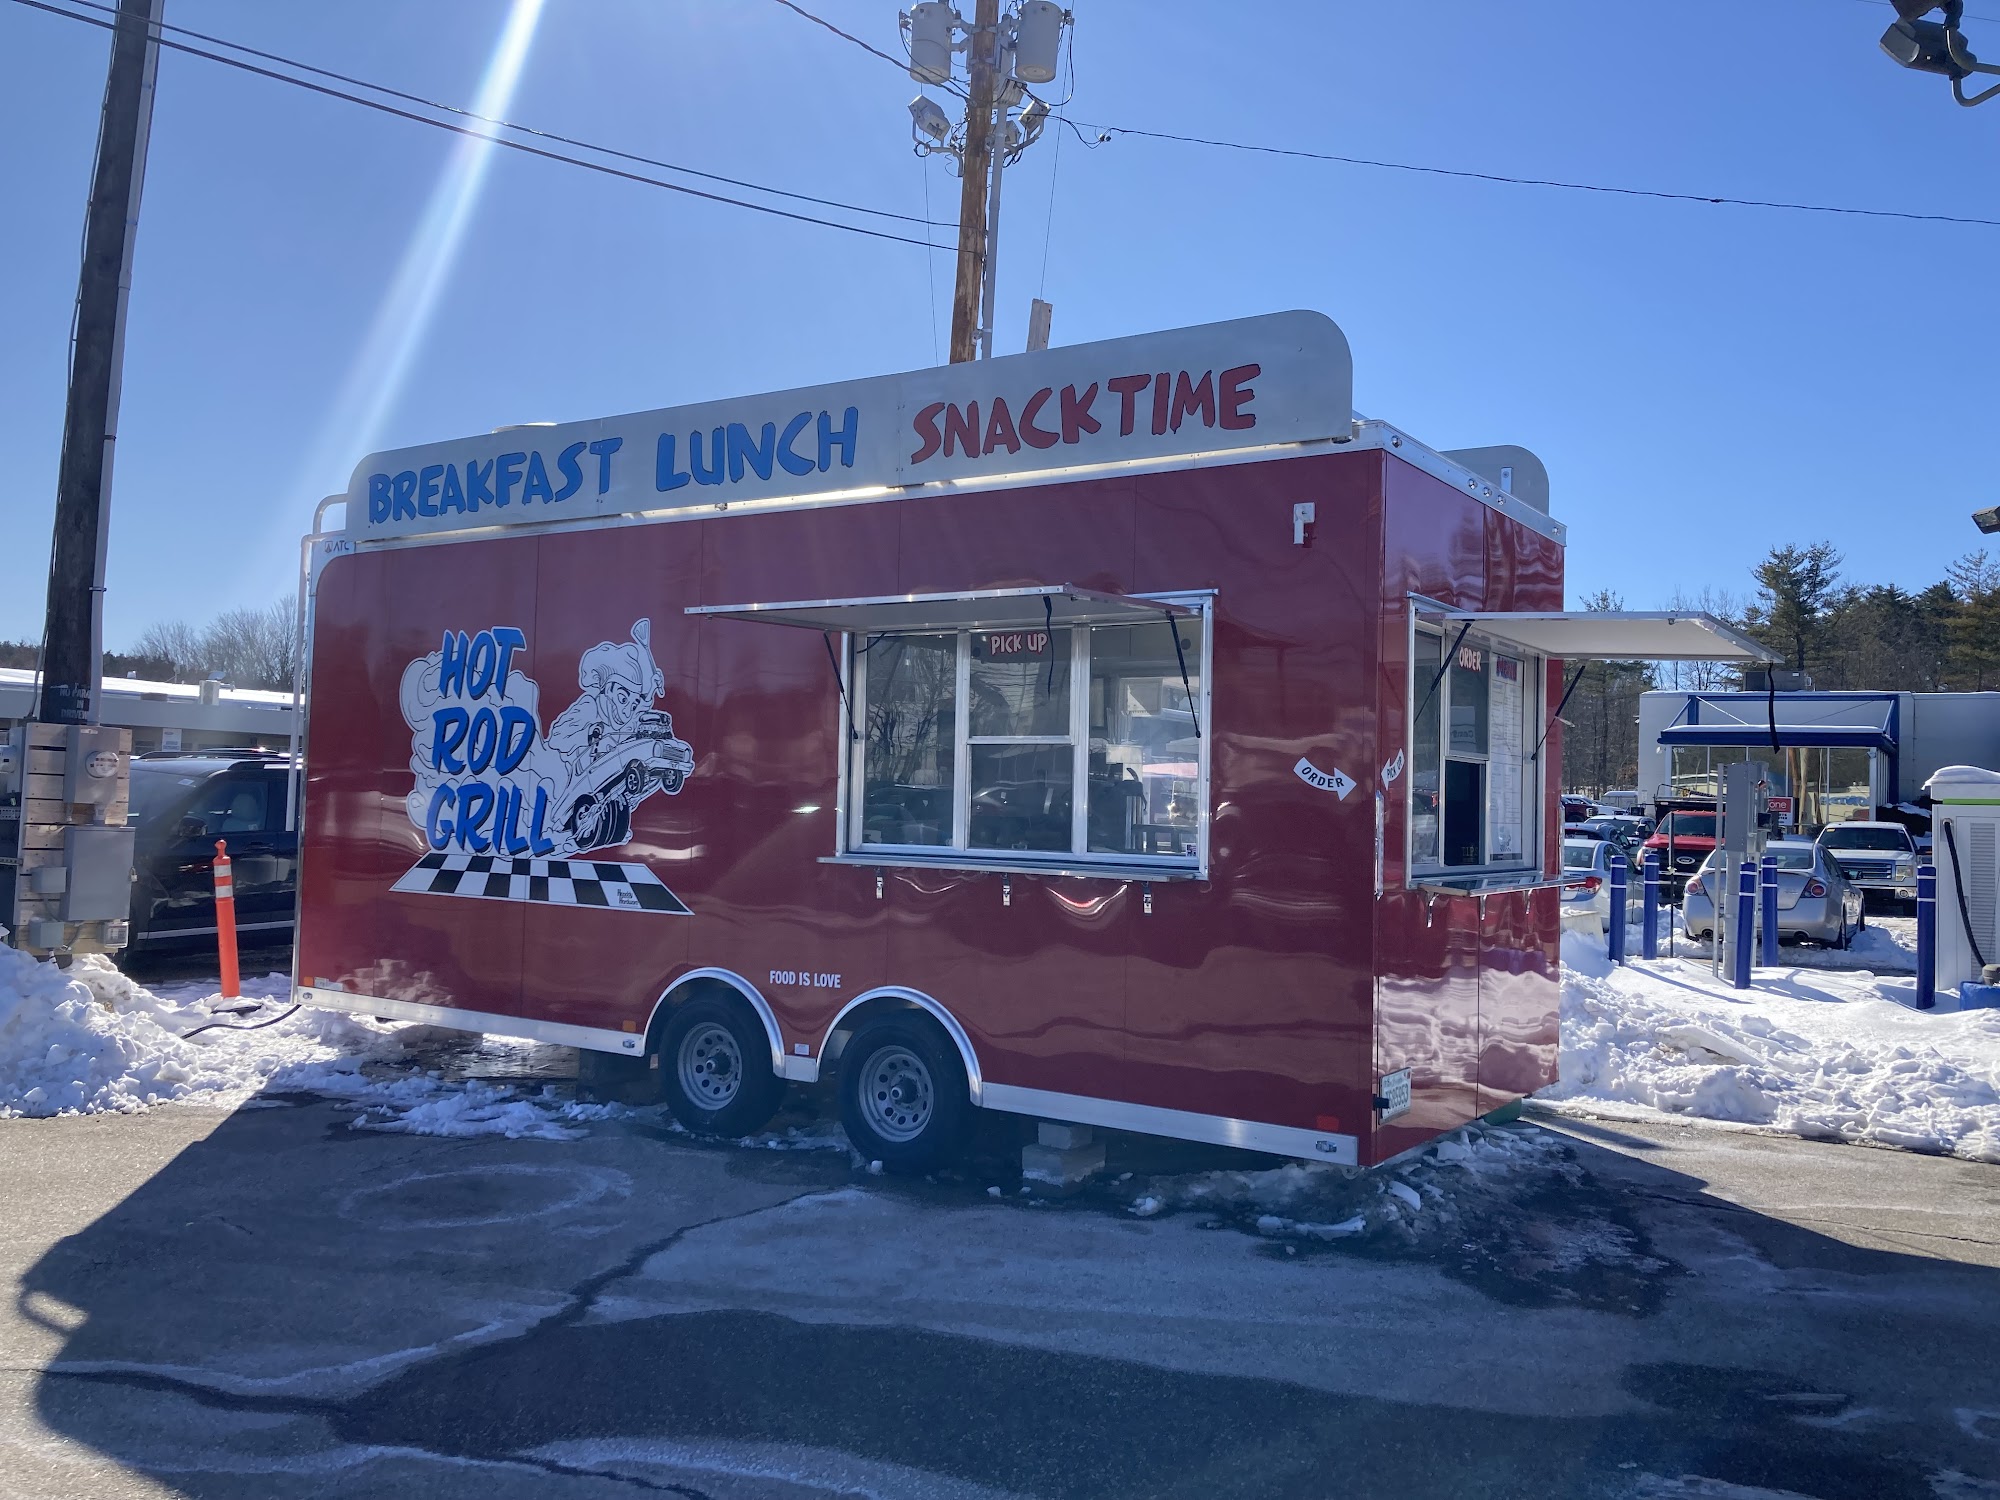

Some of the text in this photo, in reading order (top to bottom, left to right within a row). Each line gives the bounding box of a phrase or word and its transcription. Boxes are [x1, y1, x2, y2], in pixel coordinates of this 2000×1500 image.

[368, 437, 623, 524] BREAKFAST
[656, 407, 858, 492] LUNCH
[333, 540, 349, 551] ATC
[991, 633, 1048, 655] PICK UP
[438, 626, 526, 700] HOT
[1459, 647, 1481, 671] ORDER
[432, 706, 536, 775] ROD
[1301, 766, 1345, 788] ORDER
[1387, 756, 1403, 779] PICK UP
[427, 784, 555, 857] GRILL
[769, 970, 841, 988] FOOD IS LOVE
